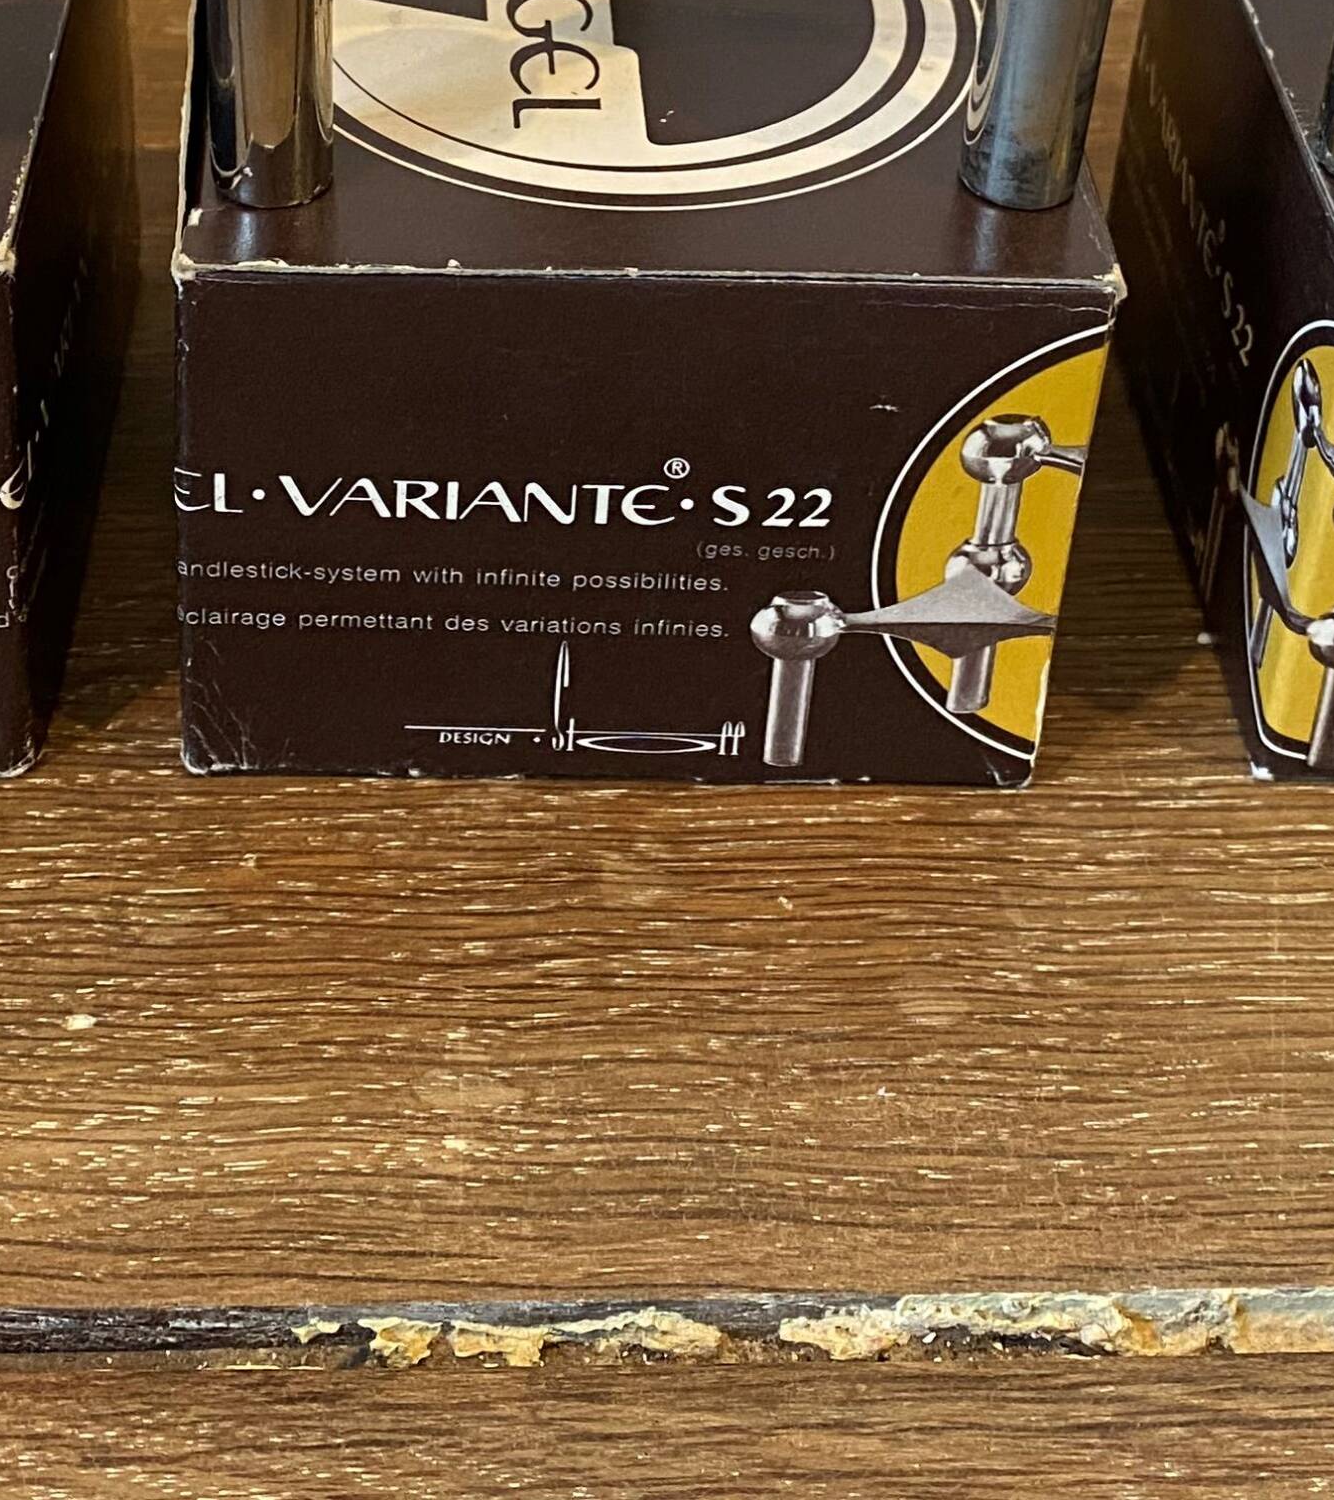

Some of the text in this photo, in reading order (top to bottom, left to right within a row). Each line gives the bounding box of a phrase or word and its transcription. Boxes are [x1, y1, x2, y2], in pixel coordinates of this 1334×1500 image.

[413, 567, 464, 585] with
[477, 567, 561, 588] infinite
[572, 571, 730, 592] possibilities.
[299, 612, 433, 631] permettant
[444, 613, 490, 632] des
[501, 617, 622, 636] variations
[634, 619, 730, 638] infinies.
[438, 730, 513, 746] DESIGN
